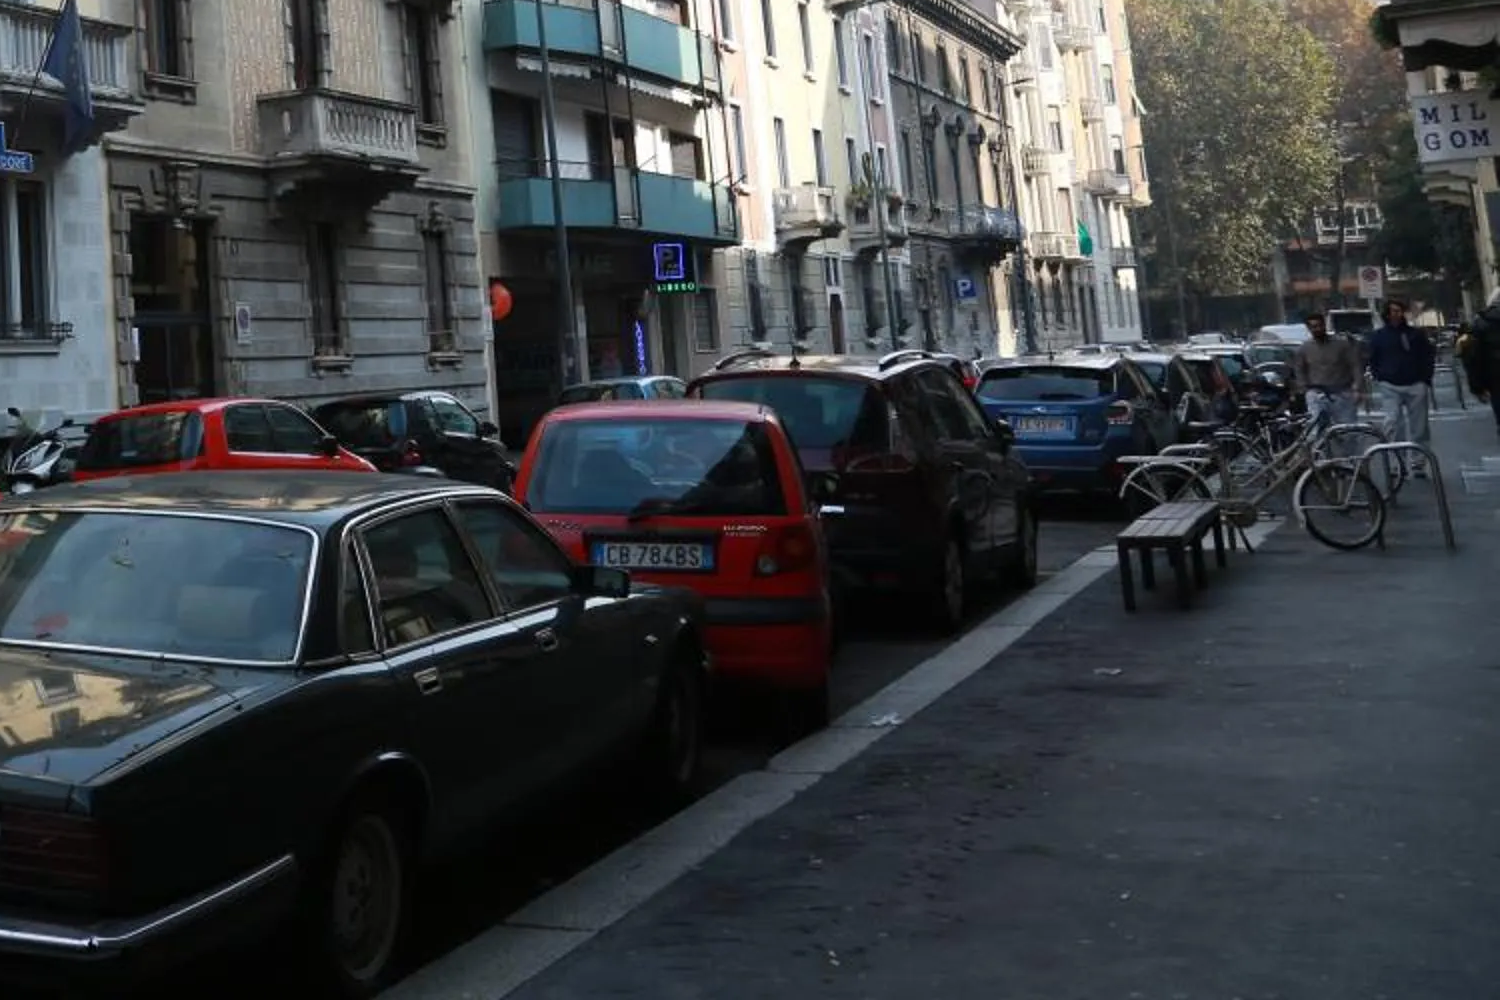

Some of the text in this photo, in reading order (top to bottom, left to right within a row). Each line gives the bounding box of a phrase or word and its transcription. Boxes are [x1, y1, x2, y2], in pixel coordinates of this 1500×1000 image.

[1419, 103, 1486, 124] MIL
[1424, 128, 1492, 150] GOM
[957, 279, 971, 297] P
